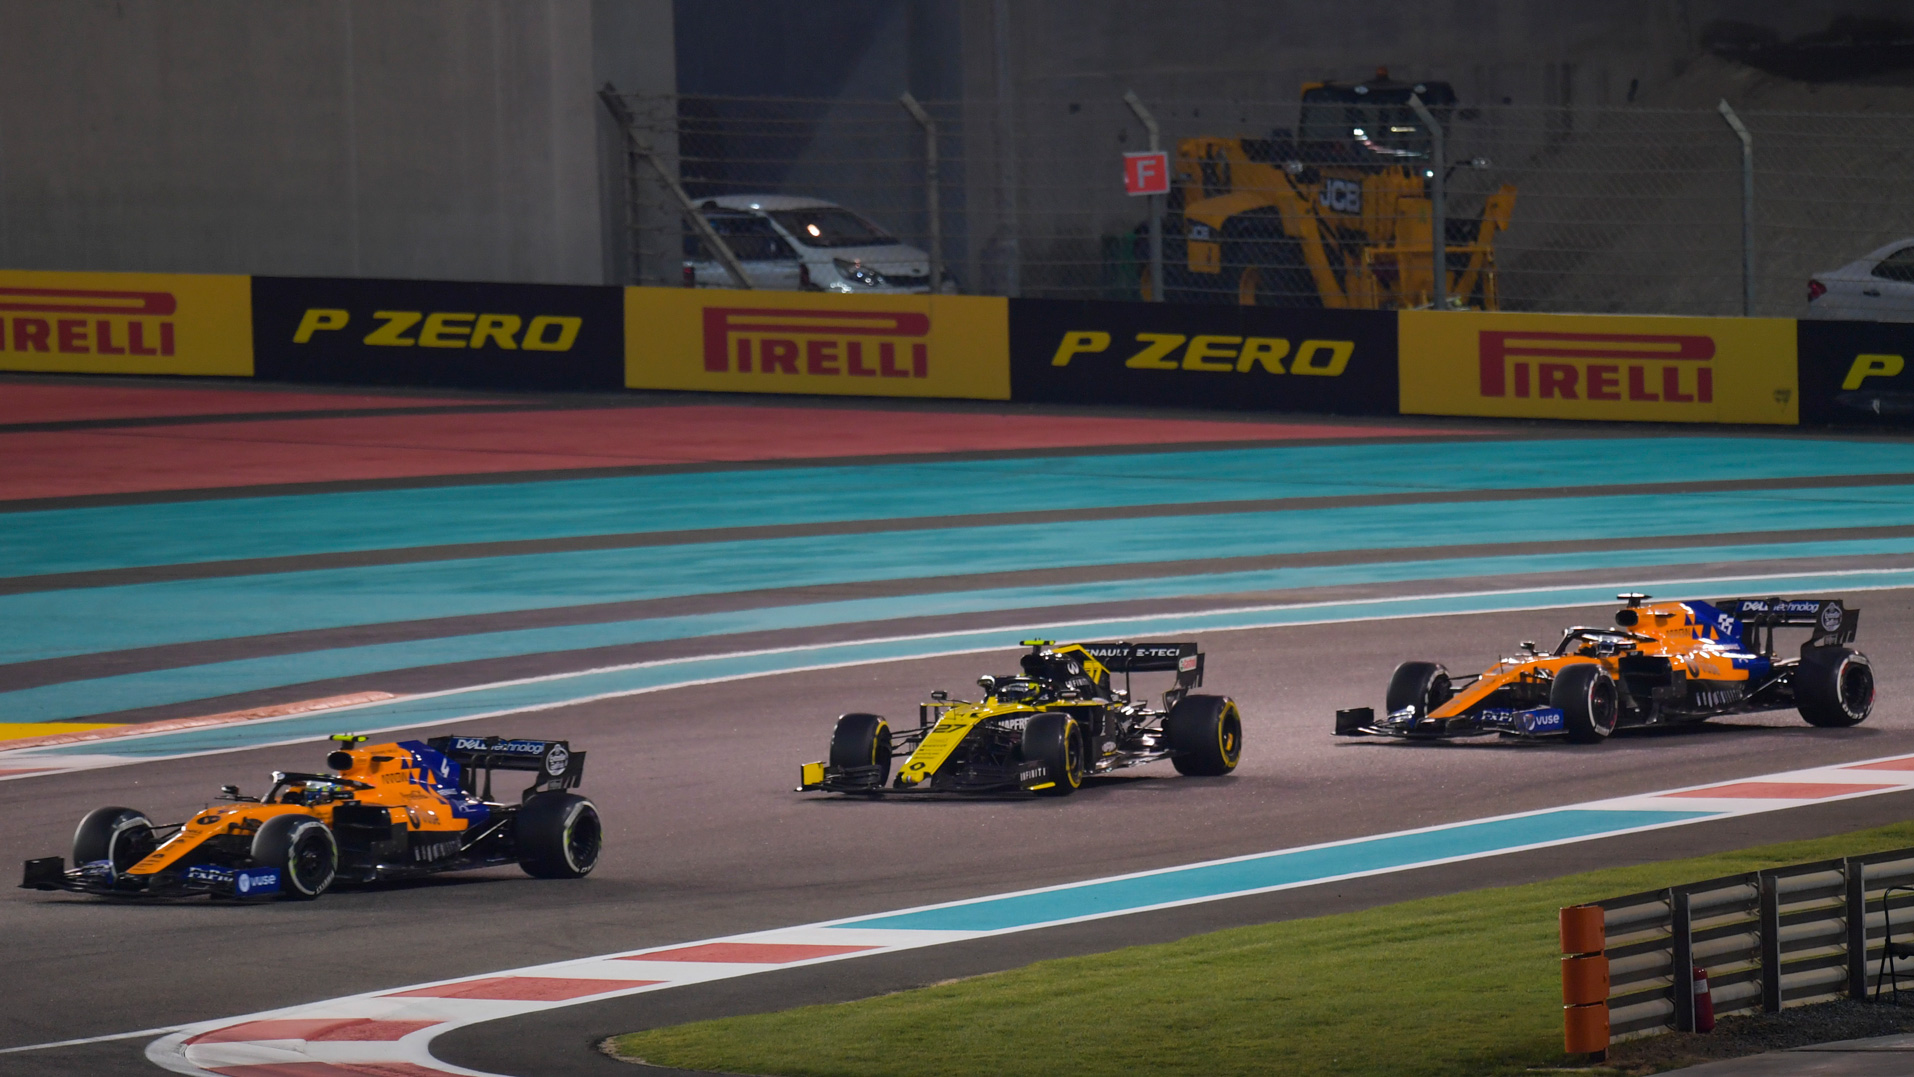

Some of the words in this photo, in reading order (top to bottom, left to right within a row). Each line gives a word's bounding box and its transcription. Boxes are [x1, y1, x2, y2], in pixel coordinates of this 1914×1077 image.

[1137, 159, 1157, 189] F
[1320, 178, 1361, 214] JCB
[0, 287, 177, 357] RELLI
[295, 309, 350, 344] P
[364, 311, 583, 352] ZERO
[703, 306, 932, 379] PIRELLI
[1053, 332, 1111, 367] P
[1126, 334, 1355, 377] ZERO
[1478, 330, 1716, 404] PIRELLI
[1842, 354, 1905, 390] P
[931, 724, 967, 733] 27
[1536, 714, 1560, 726] vuse
[441, 758, 450, 779] 4
[250, 873, 277, 887] vuse
